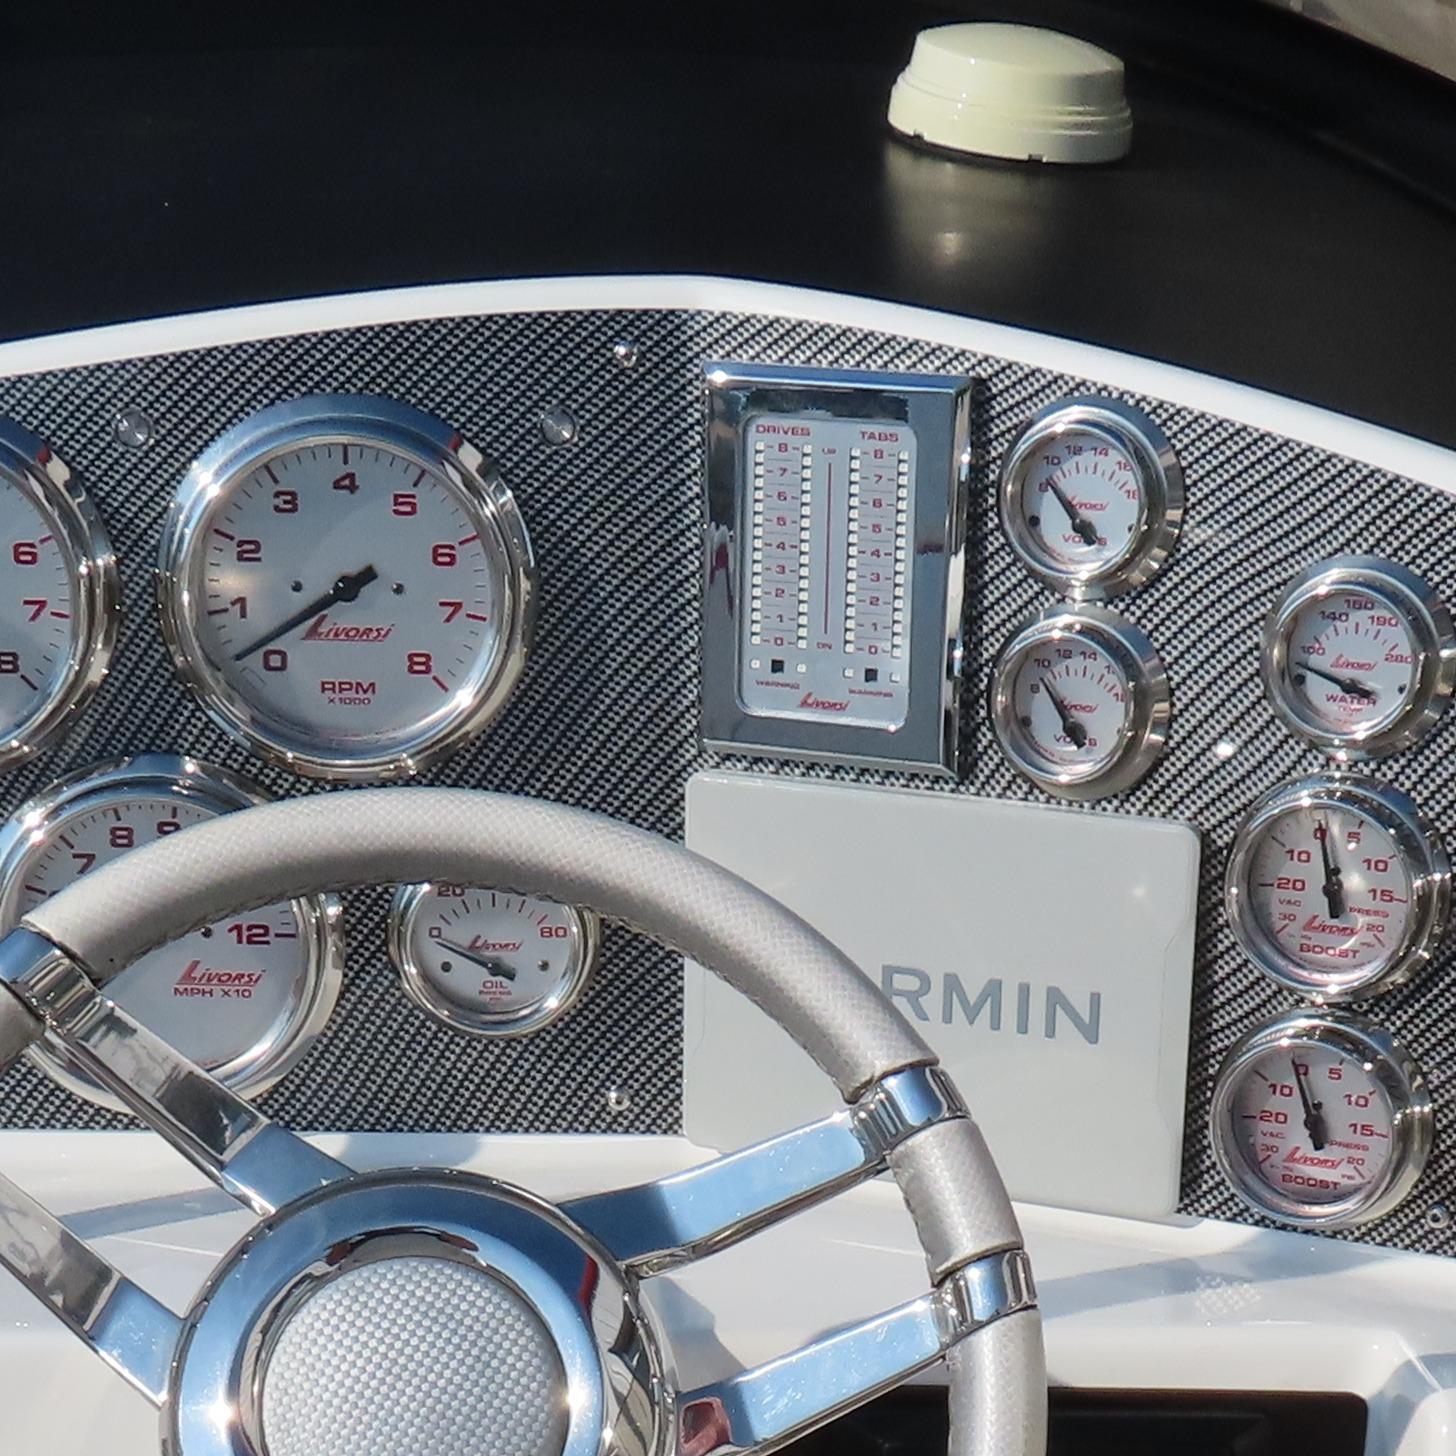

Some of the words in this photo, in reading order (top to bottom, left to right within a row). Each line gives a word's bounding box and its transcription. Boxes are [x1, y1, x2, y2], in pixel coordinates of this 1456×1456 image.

[756, 425, 810, 436] DRIVES
[860, 431, 899, 442] TABS
[1093, 448, 1109, 457] 14
[1044, 456, 1061, 466] 10
[779, 468, 788, 476] 7
[333, 473, 359, 494] 4
[874, 475, 882, 484] 7
[273, 491, 298, 513] 3
[392, 494, 417, 515] 5
[237, 540, 261, 562] 2
[776, 542, 785, 550] 4
[13, 543, 38, 565] 6
[432, 545, 456, 567] 6
[871, 550, 880, 558] 4
[775, 565, 785, 574] 3
[870, 573, 880, 582] 3
[775, 589, 785, 598] 2
[229, 597, 247, 618] 1
[869, 597, 879, 606] 2
[23, 600, 48, 622] 7
[439, 601, 463, 623] 7
[1319, 611, 1349, 623] 140
[776, 614, 783, 622] 1
[872, 623, 878, 631] 1
[774, 638, 783, 646] 0
[868, 645, 877, 655] 0
[1079, 651, 1097, 661] 14
[263, 650, 287, 671] 0
[407, 653, 432, 675] 8
[1034, 658, 1051, 668] 10
[321, 681, 376, 695] RPM
[1326, 694, 1377, 707] WATER
[110, 827, 134, 847] 8
[1347, 832, 1360, 844] 5
[1285, 849, 1310, 862] 10
[72, 853, 95, 874] 7
[1362, 858, 1388, 872] 10
[1276, 877, 1305, 891] 20
[437, 887, 465, 897] 20
[1368, 889, 1393, 902] 15
[1278, 913, 1296, 921] 30
[429, 927, 442, 937] 0
[540, 927, 567, 938] 80
[1366, 923, 1384, 933] 20
[227, 924, 270, 945] 12
[1299, 943, 1360, 958] BOOST
[483, 981, 508, 989] OIL
[173, 988, 213, 998] MPH
[221, 988, 252, 998] X10
[881, 965, 1101, 1045] RMIN
[1328, 1068, 1341, 1080] 5
[1269, 1084, 1293, 1096] 10
[1344, 1093, 1369, 1107] 10
[1259, 1110, 1288, 1124] 20
[1349, 1124, 1374, 1137] 15
[1261, 1144, 1279, 1154] 30
[1347, 1157, 1365, 1166] 20
[1282, 1174, 1340, 1190] BOOST
